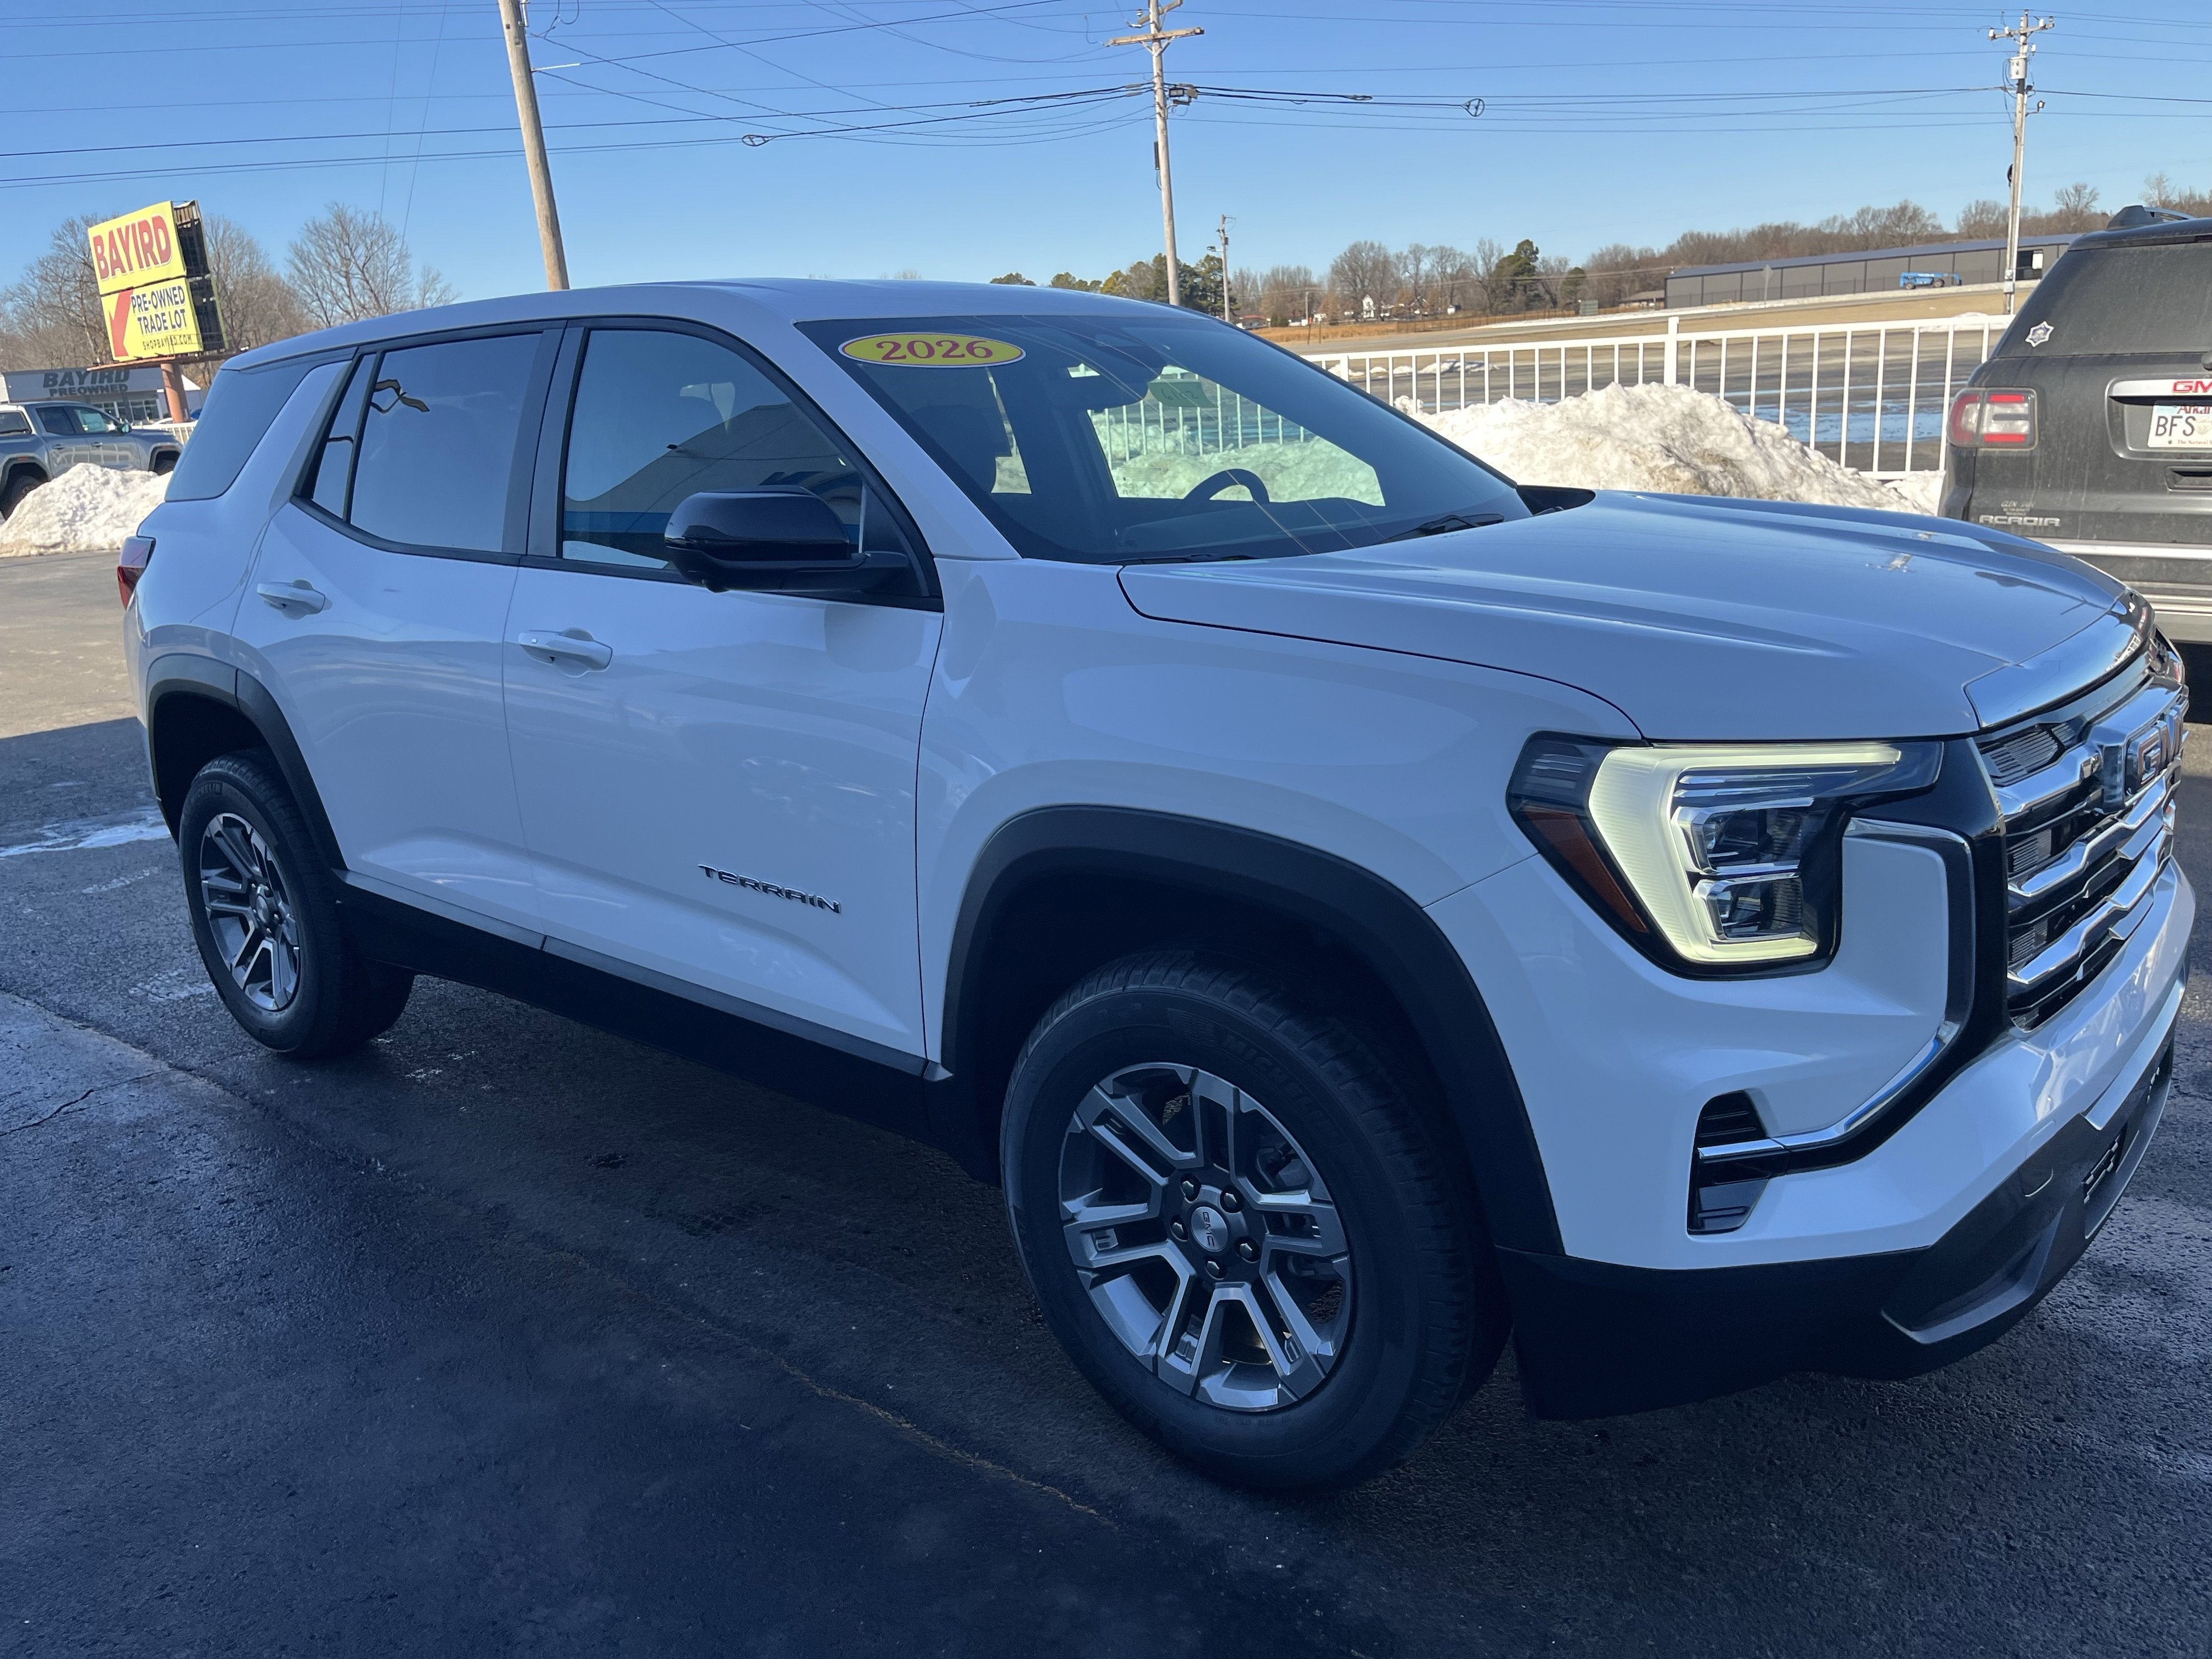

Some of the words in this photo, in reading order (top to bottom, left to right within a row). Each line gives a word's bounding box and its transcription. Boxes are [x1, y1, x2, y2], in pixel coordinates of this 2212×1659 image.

[92, 215, 172, 281] BAYIRD
[131, 285, 185, 314] PRE-OWNED
[137, 312, 169, 335] TRADE
[168, 308, 187, 330] LOT
[876, 340, 994, 362] 2026
[43, 369, 130, 388] BAYIRD
[49, 383, 128, 397] PREOWNED
[2155, 415, 2197, 437] BFS
[1978, 514, 2061, 527] ACADIA
[697, 864, 842, 915] TERRAIN
[1202, 1211, 1216, 1247] GMC
